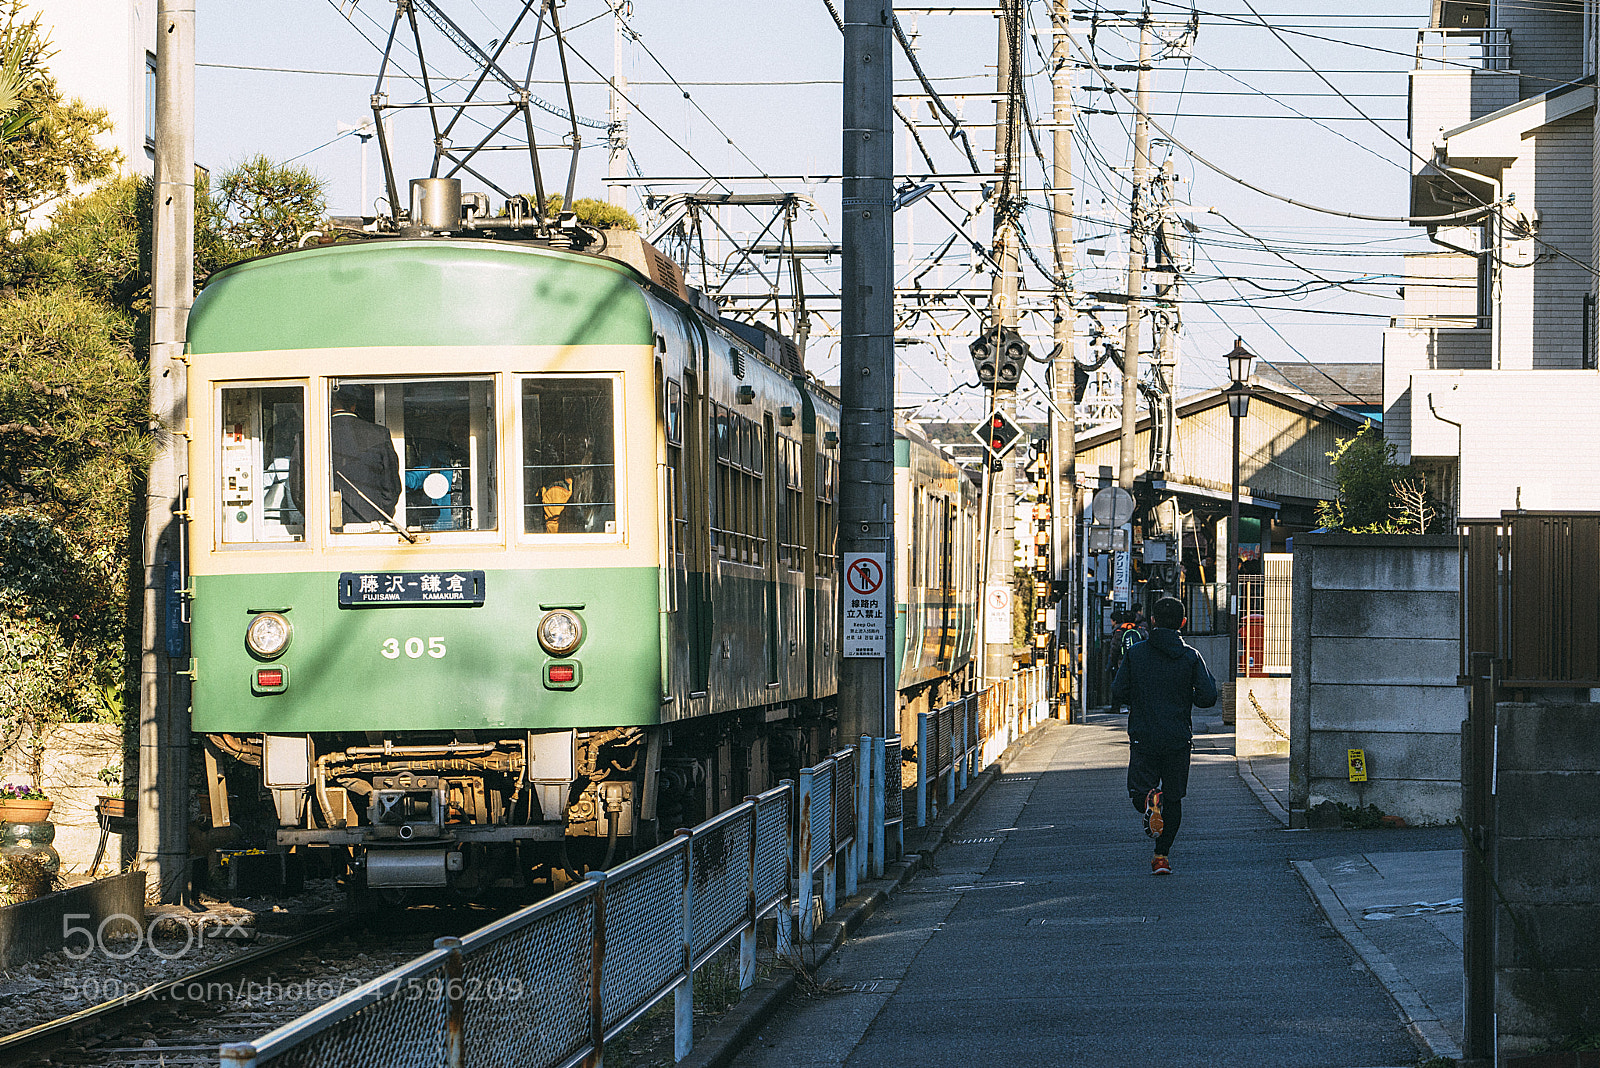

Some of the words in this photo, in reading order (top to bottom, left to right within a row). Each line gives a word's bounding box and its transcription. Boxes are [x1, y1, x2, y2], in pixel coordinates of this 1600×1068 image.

[422, 592, 464, 600] KAMAKURA
[852, 600, 878, 608] 線路内
[846, 610, 882, 618] 立入禁止
[381, 636, 447, 659] 305
